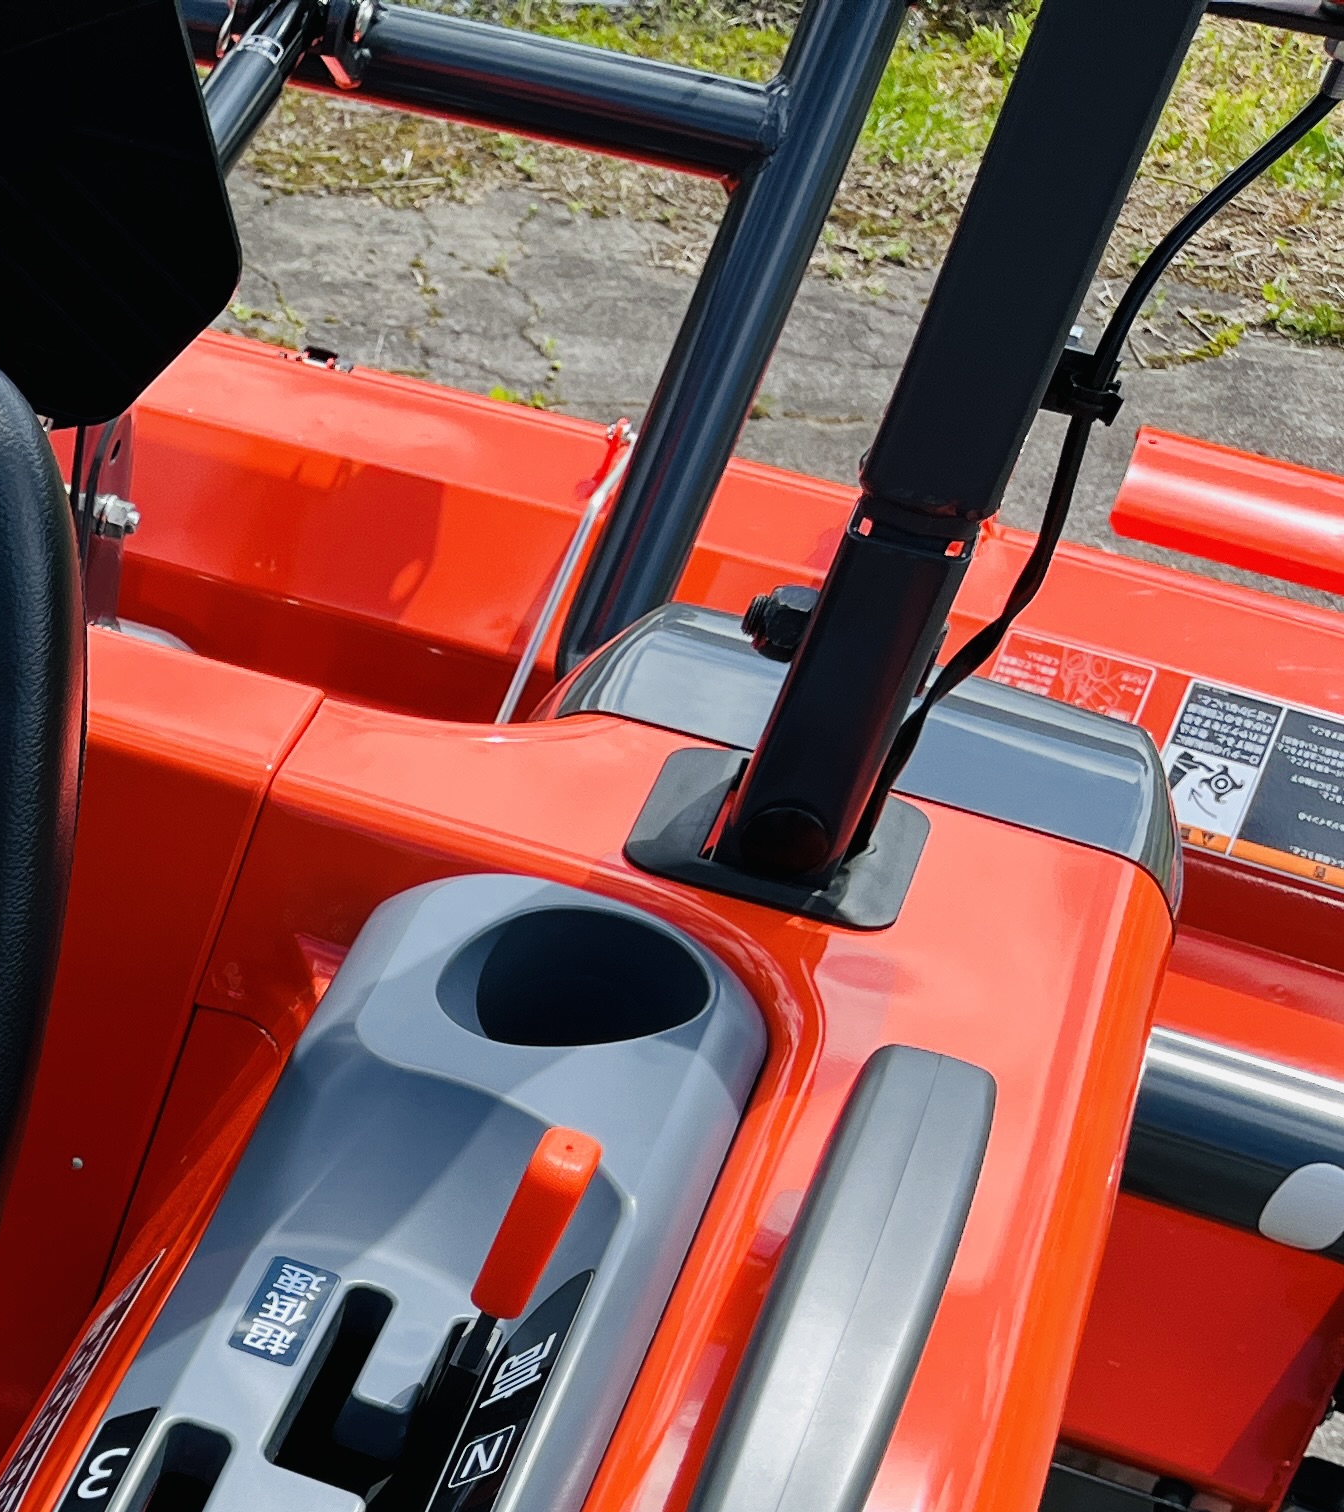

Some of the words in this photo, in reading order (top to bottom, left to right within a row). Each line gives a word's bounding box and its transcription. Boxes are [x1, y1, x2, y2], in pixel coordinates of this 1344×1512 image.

[243, 1263, 327, 1357] 超低速
[479, 1332, 558, 1409] 高
[77, 1447, 130, 1500] 3
[460, 1435, 504, 1479] N
